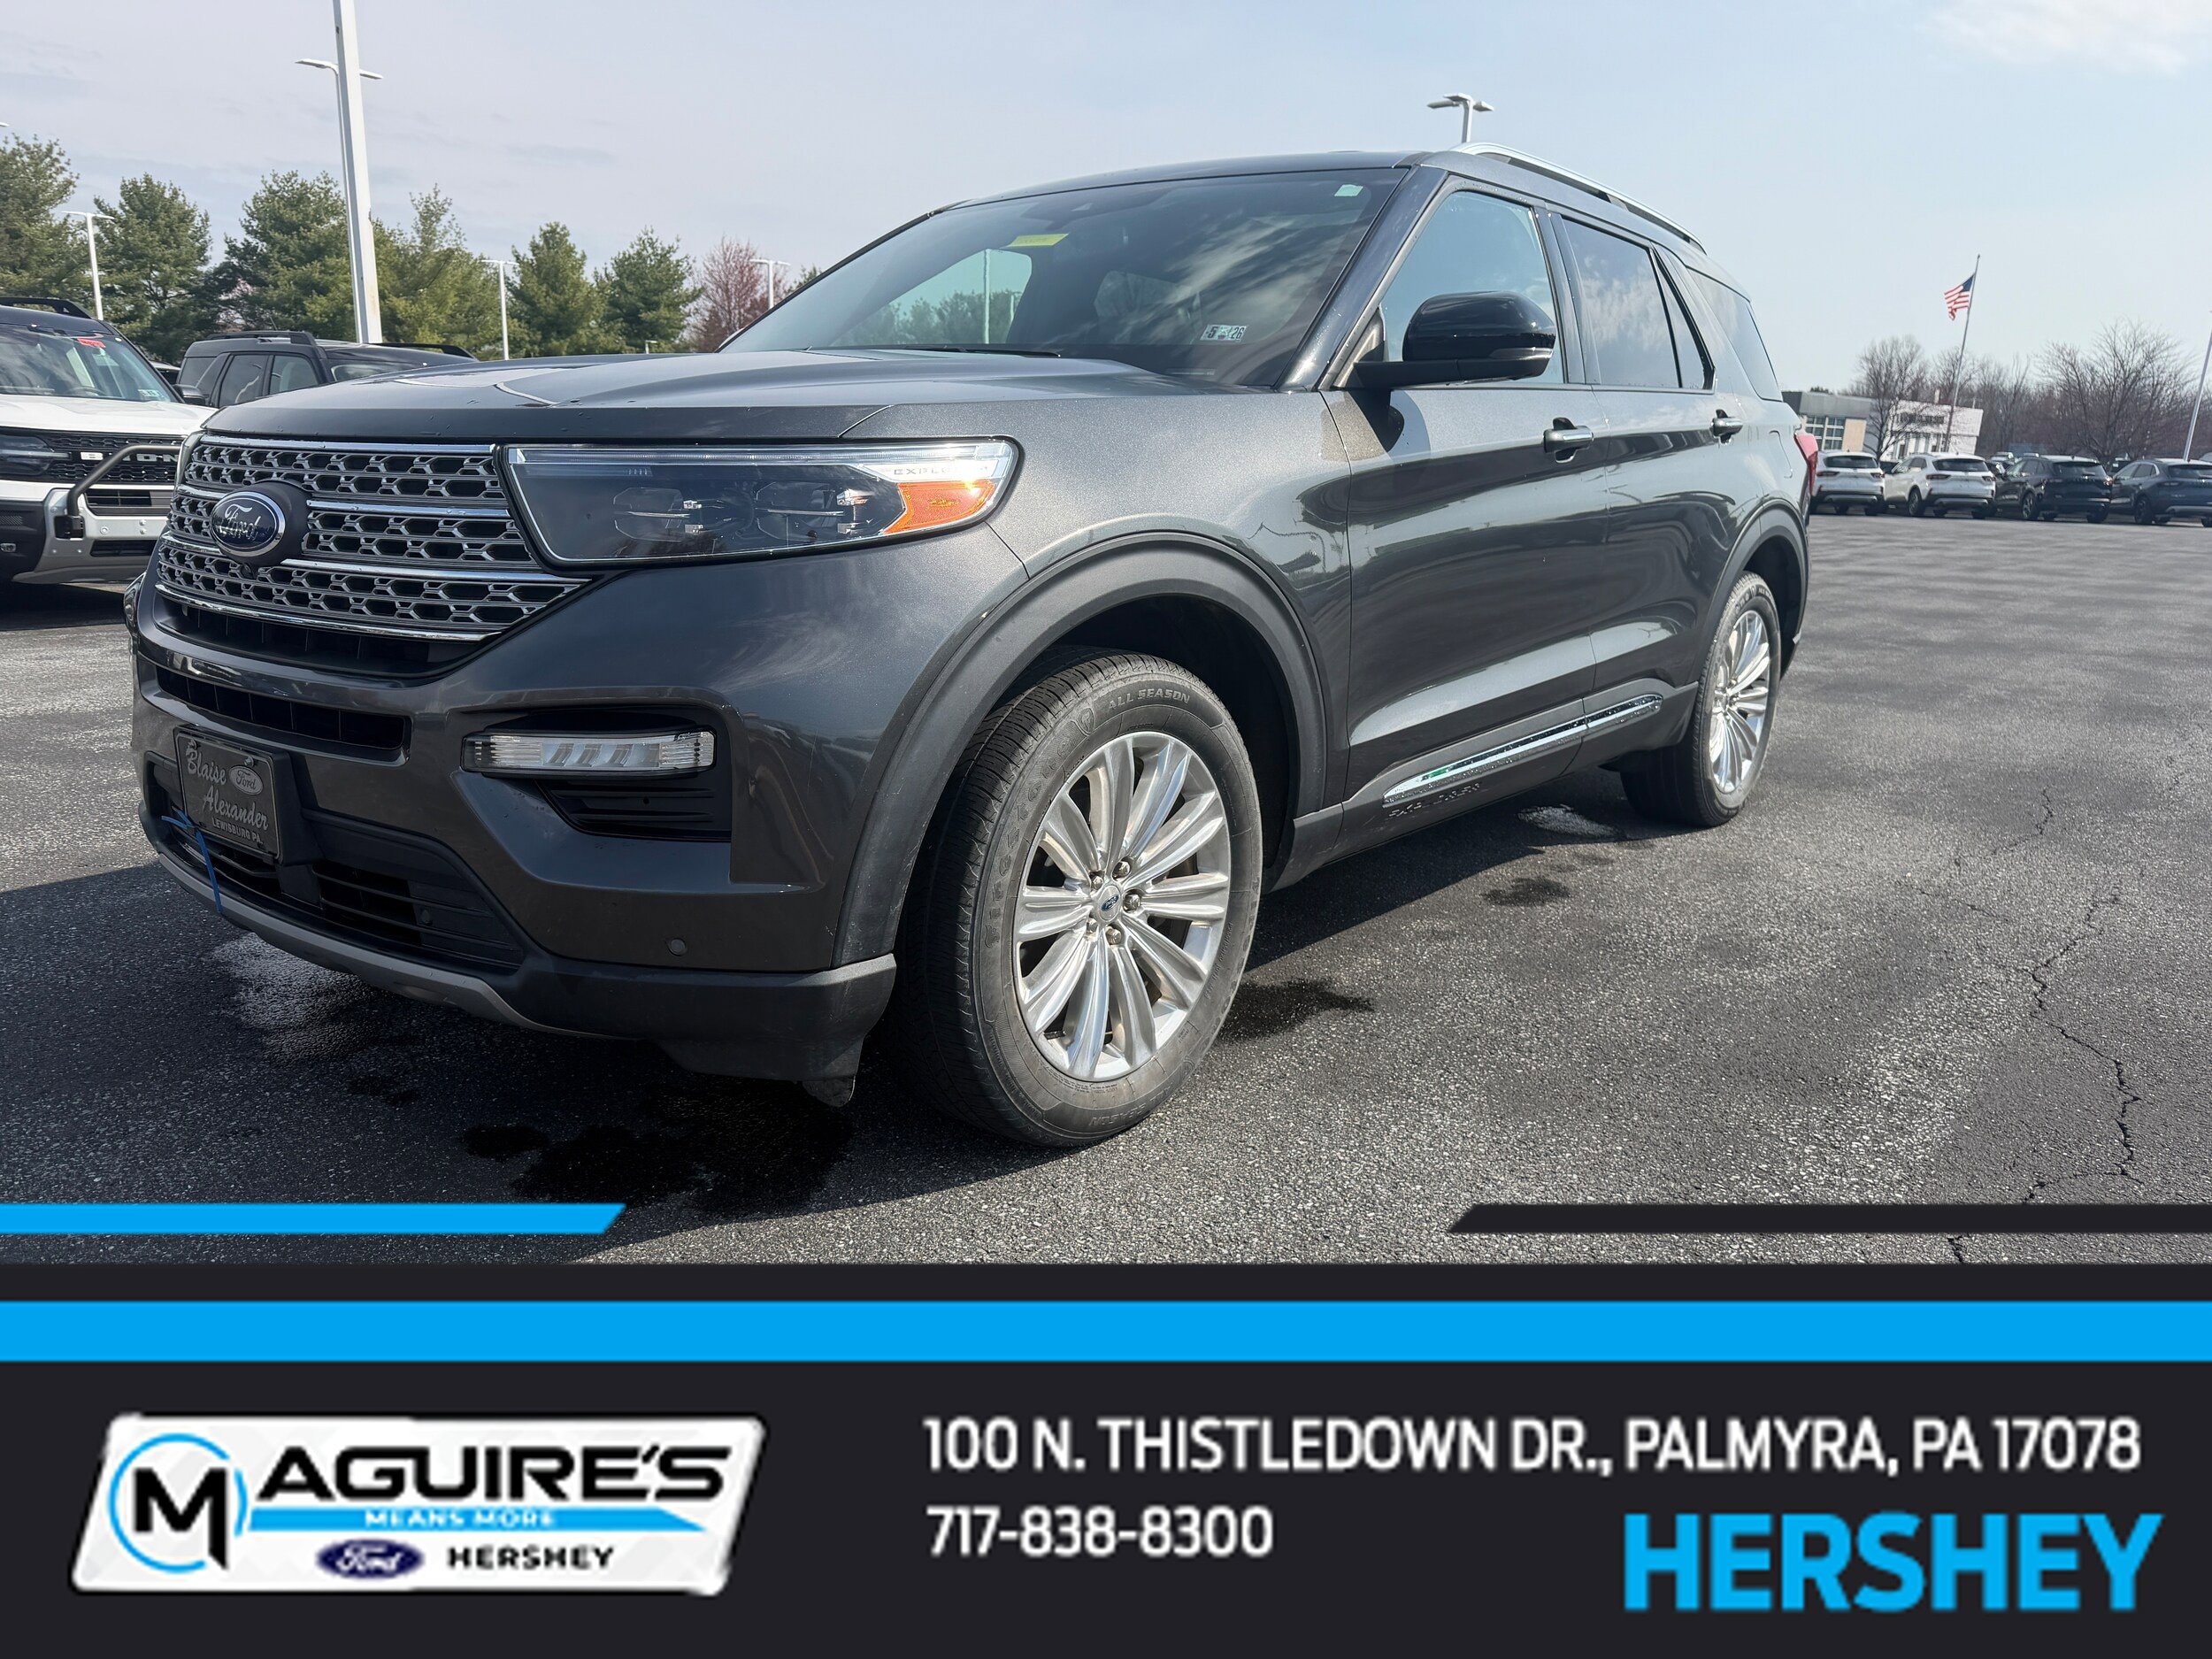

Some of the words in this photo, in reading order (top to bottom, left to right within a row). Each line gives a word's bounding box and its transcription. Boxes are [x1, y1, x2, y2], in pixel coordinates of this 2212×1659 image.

[1208, 326, 1218, 338] 5
[1230, 326, 1245, 339] 26
[224, 503, 262, 541] Ford
[1109, 693, 1134, 710] ALL
[1137, 688, 1191, 703] SEASON
[185, 745, 227, 785] Blaise
[235, 768, 257, 790] Ford
[203, 785, 269, 831] Alexander
[211, 817, 251, 841] LEWISBURG
